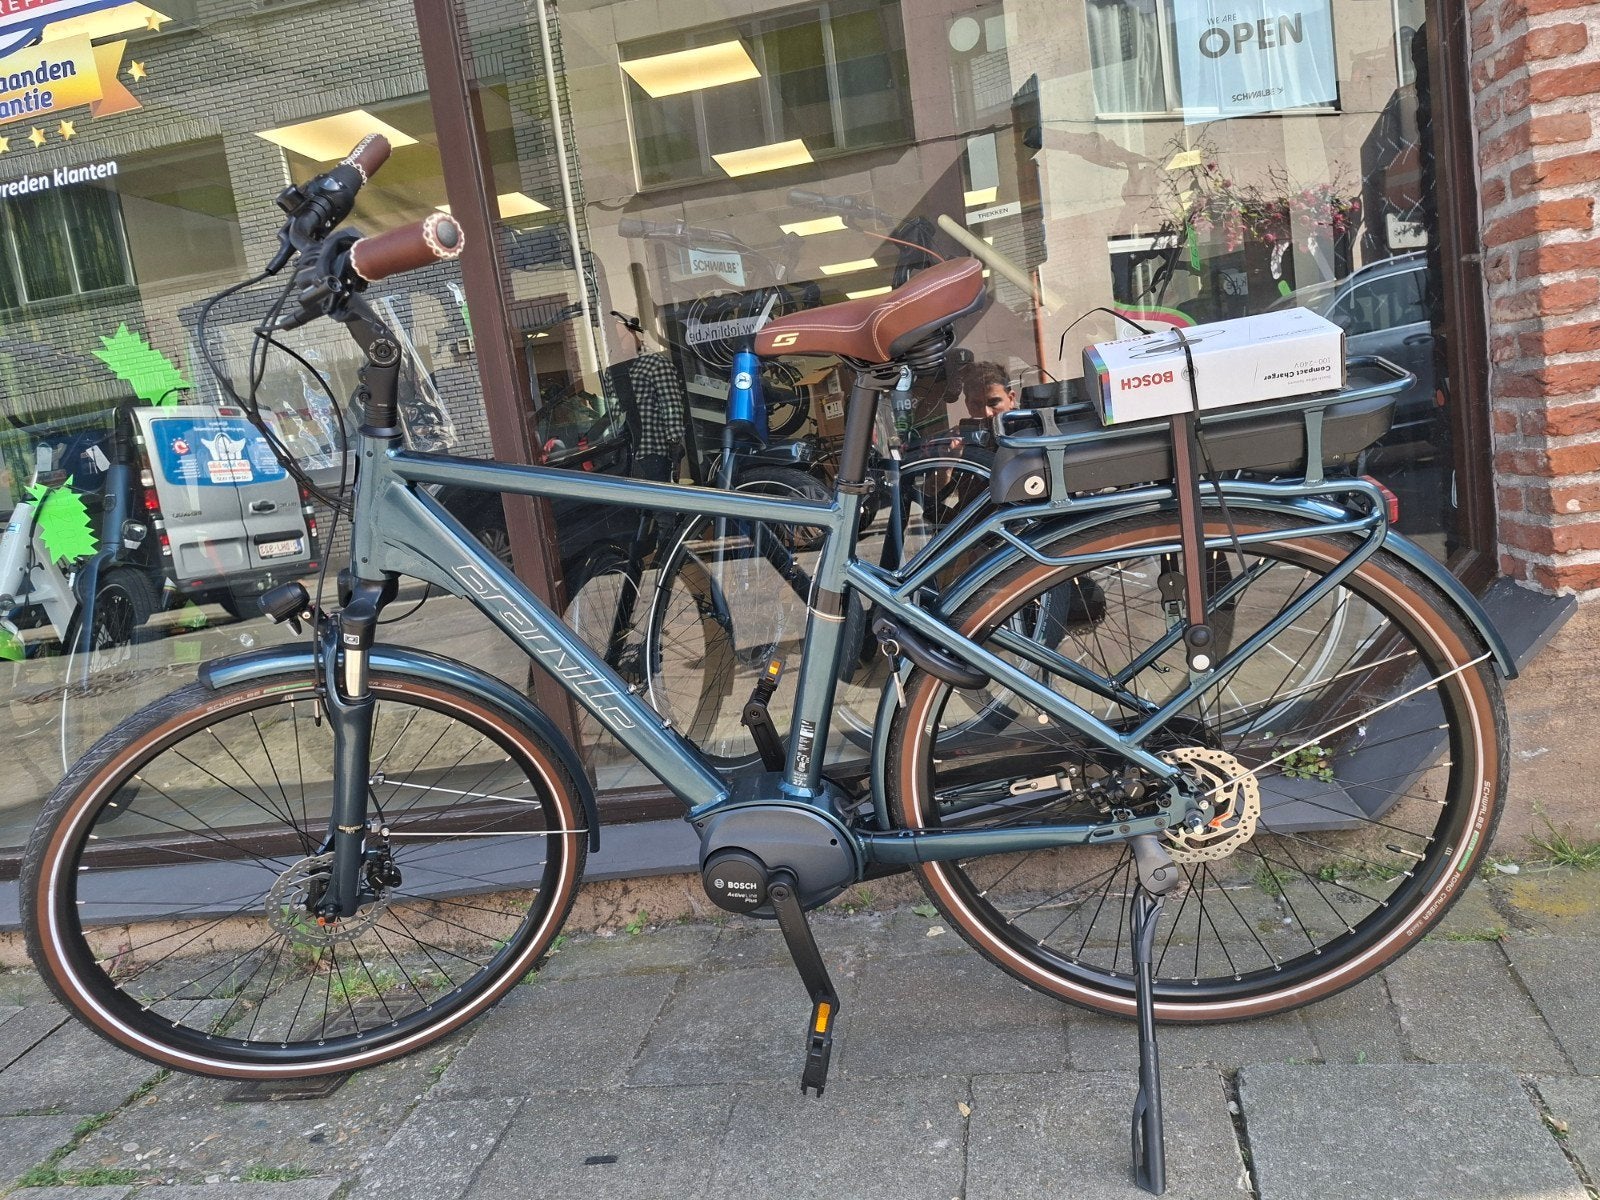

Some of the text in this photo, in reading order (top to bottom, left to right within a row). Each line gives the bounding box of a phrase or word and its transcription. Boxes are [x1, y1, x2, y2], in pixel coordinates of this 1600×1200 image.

[1207, 13, 1237, 26] WE ARE
[1199, 12, 1303, 59] OPEN
[1231, 88, 1277, 103] SCHWALBE
[0, 160, 118, 198] reden klanten
[692, 257, 738, 274] SCHWALBE
[1120, 370, 1174, 391] BOSCH
[1263, 365, 1331, 382] Compact Charger
[1475, 780, 1491, 830] SCHWALBE
[727, 881, 757, 890] BOSCH
[1423, 871, 1461, 921] ROAD CRUISER
